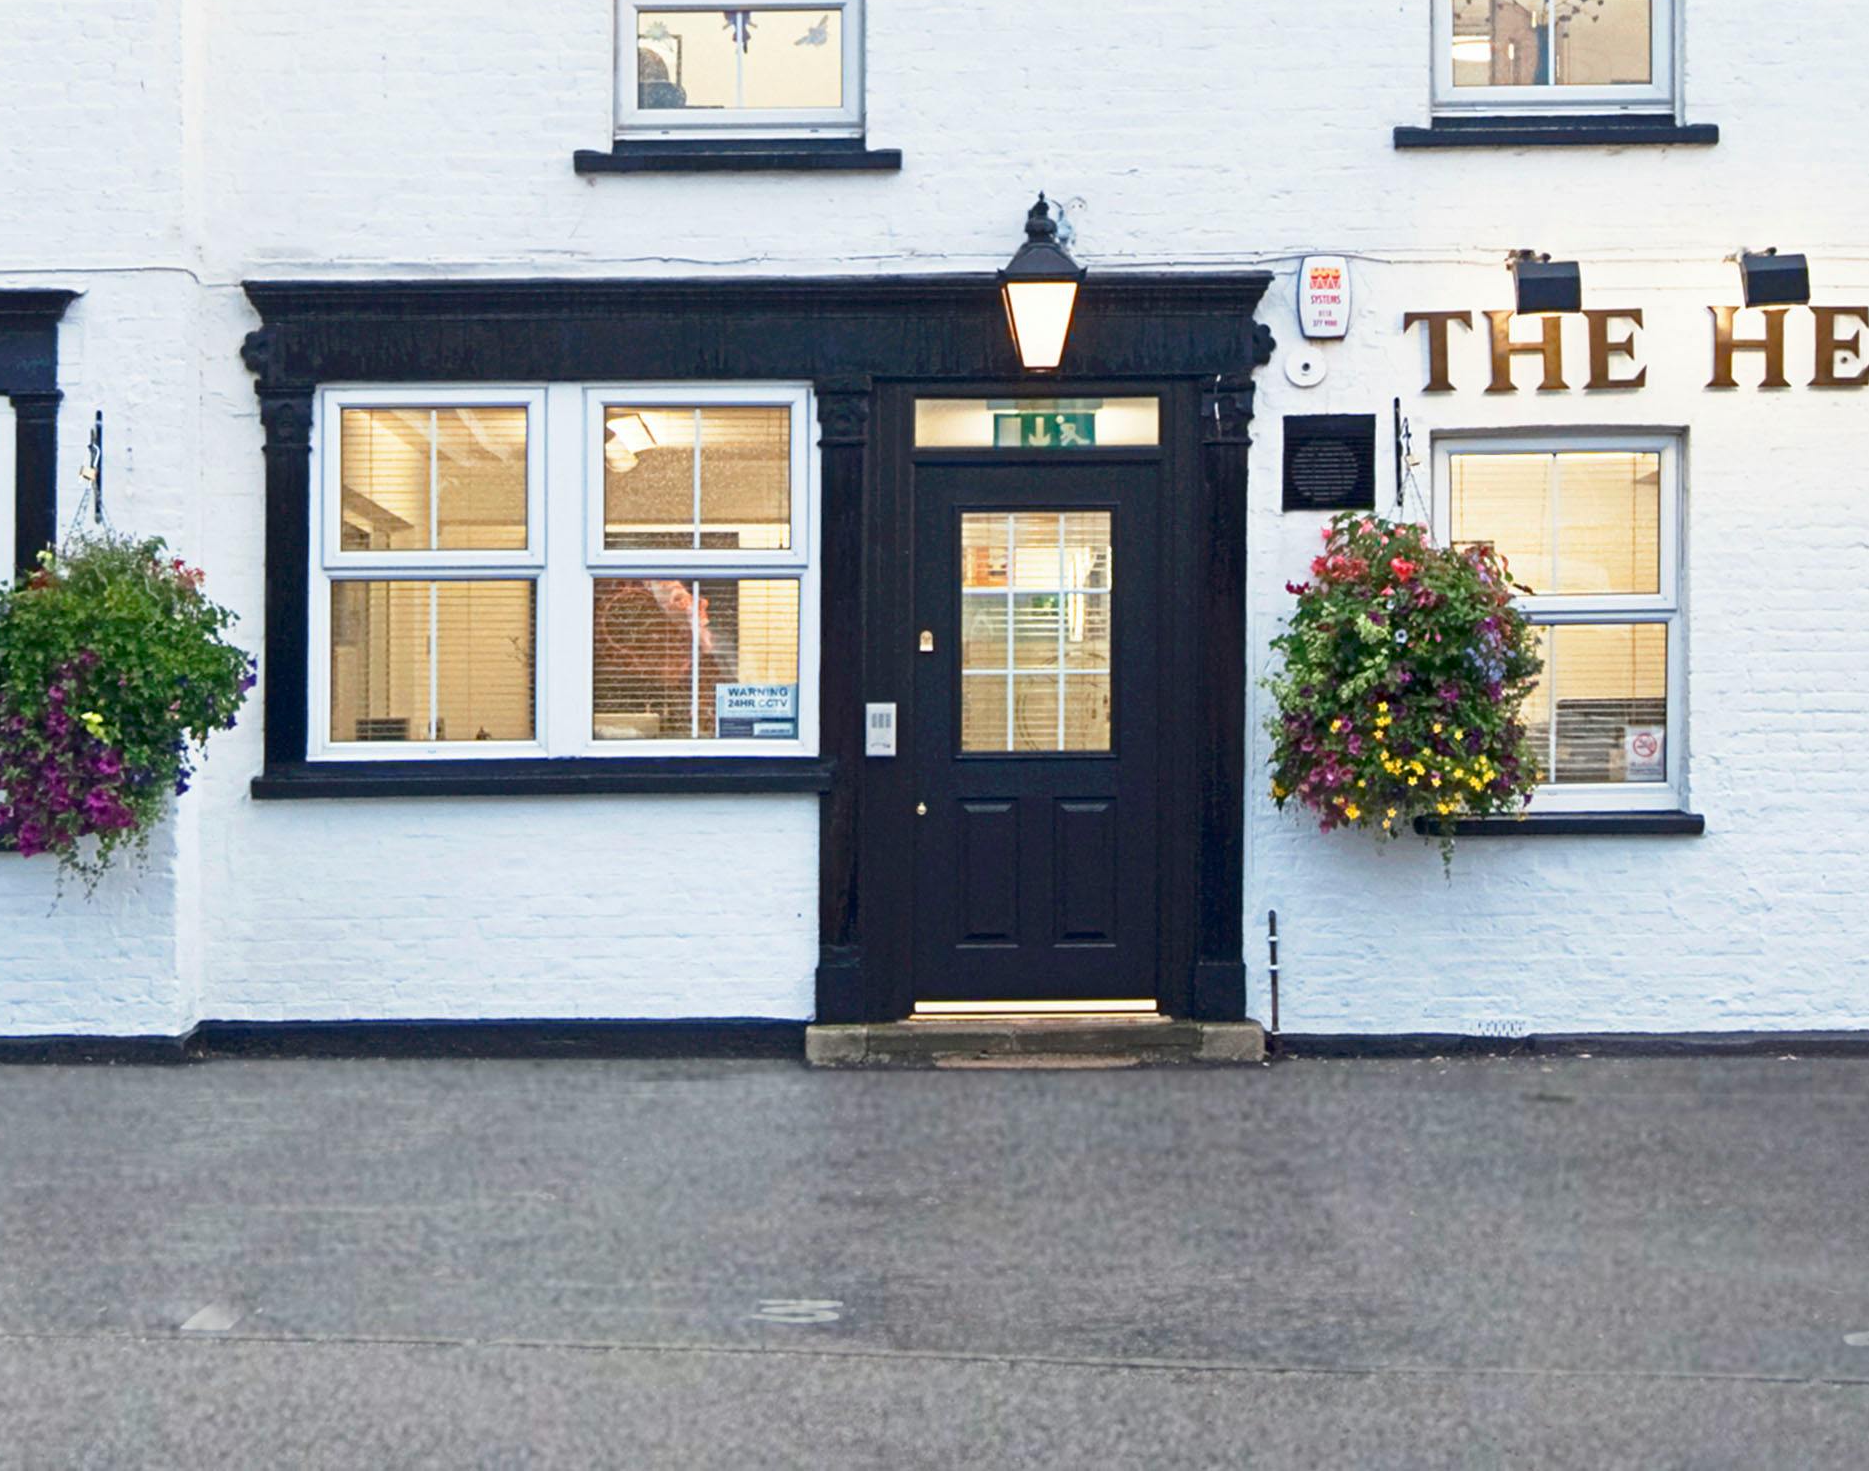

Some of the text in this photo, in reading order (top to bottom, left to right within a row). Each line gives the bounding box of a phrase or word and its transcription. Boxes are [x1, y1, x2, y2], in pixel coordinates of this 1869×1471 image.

[1310, 295, 1341, 304] SYSTEMS
[1403, 307, 1647, 392] THE
[728, 687, 788, 697] WARNING
[728, 699, 788, 708] 24HR CCTV
